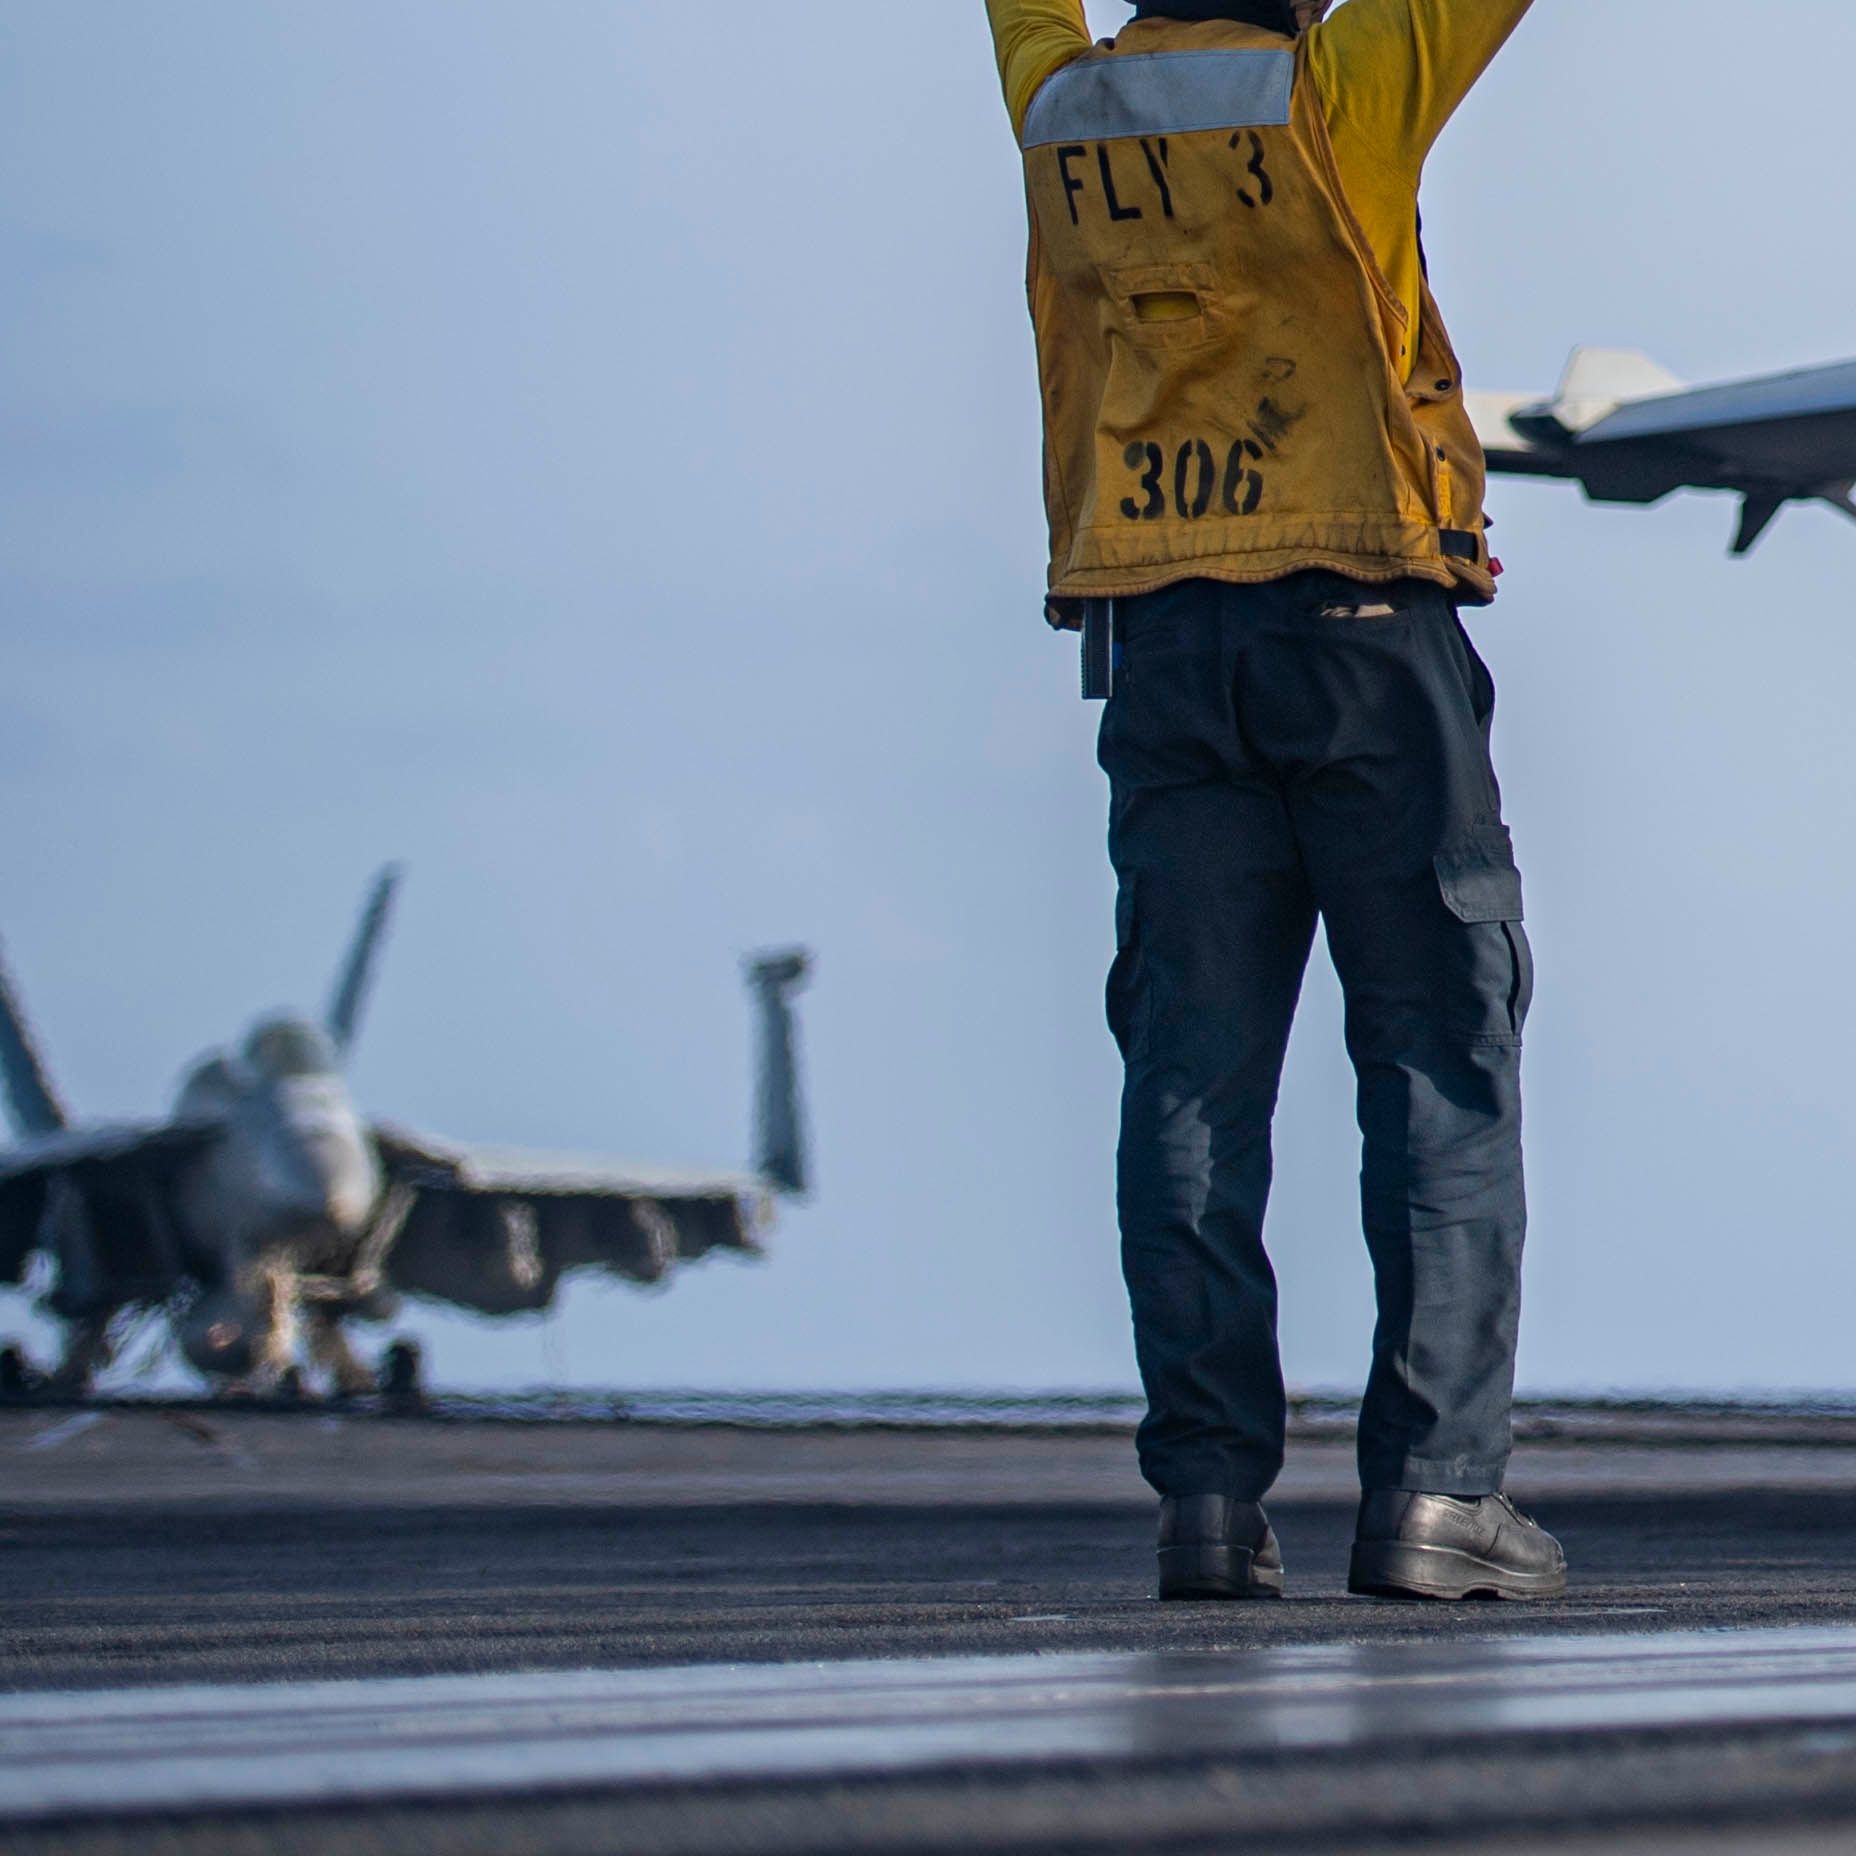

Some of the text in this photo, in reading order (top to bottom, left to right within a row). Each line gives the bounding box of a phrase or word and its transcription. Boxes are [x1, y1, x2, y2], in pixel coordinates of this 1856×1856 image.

[1057, 130, 1273, 225] FLY 3
[1120, 439, 1263, 520] 306
